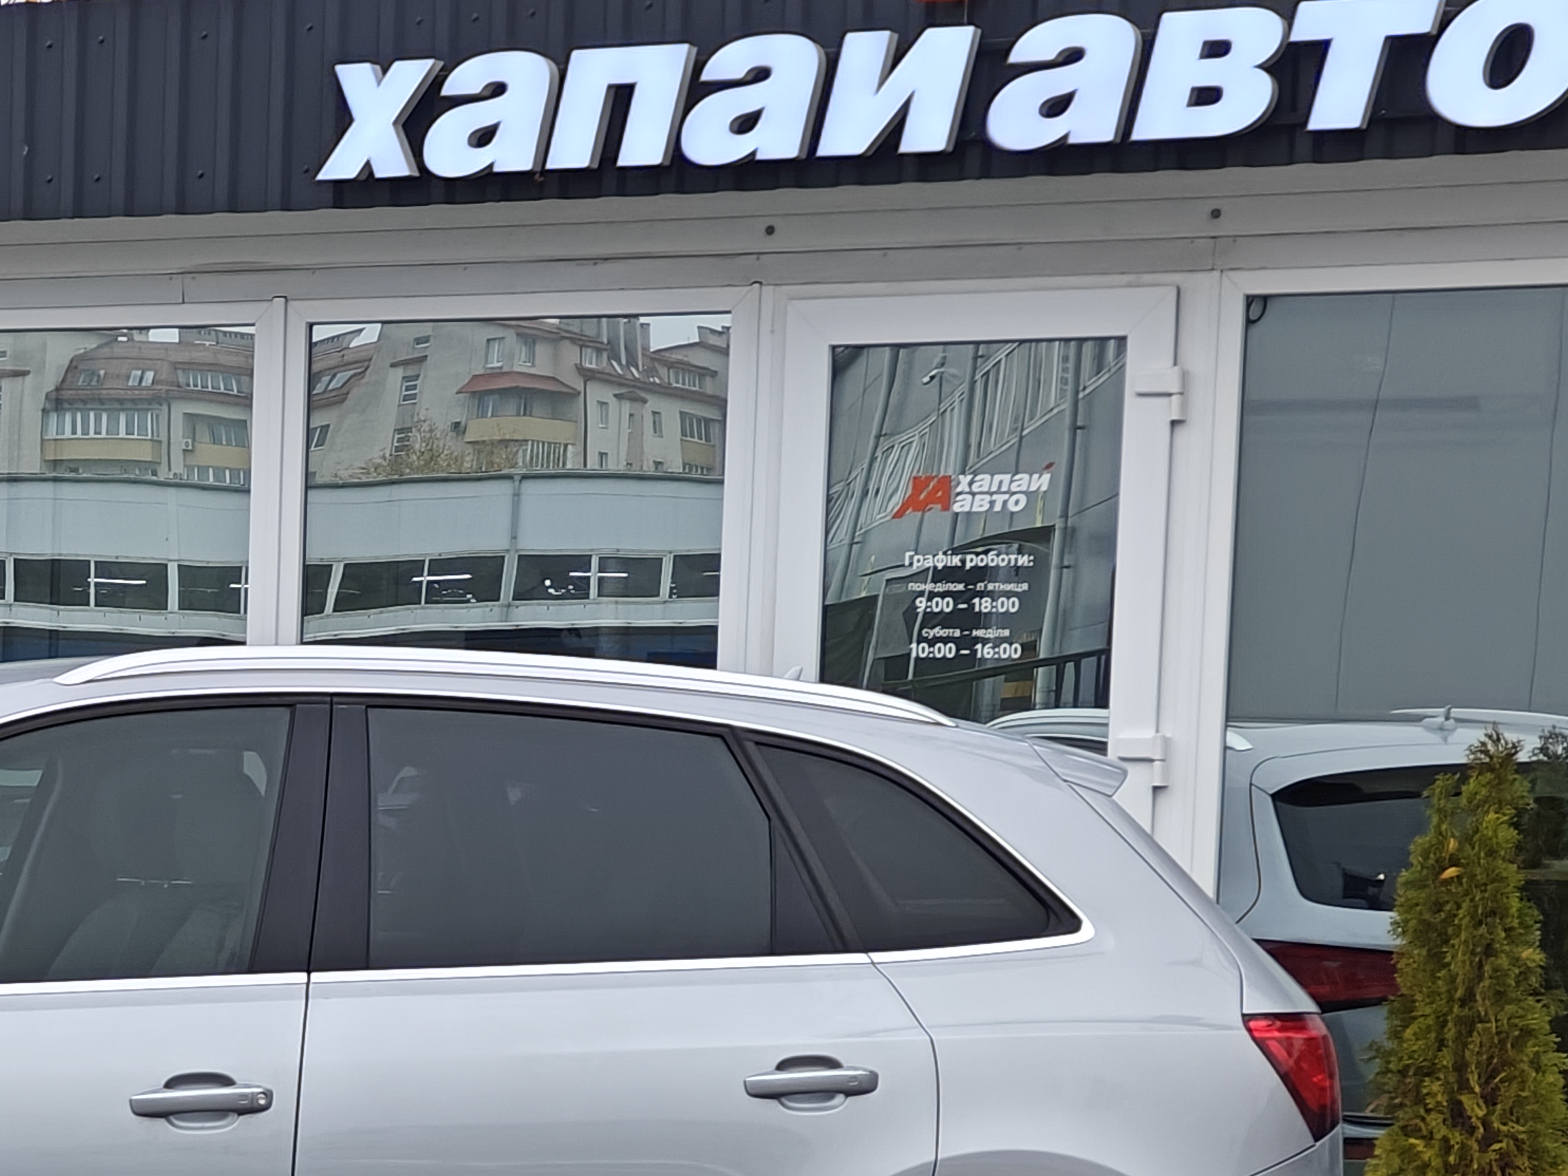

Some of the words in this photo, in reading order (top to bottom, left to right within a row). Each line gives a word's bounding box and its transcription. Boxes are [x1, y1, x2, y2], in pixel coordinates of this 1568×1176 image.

[986, 0, 1568, 152] авто
[954, 462, 1055, 493] хапай
[952, 493, 1028, 513] авто
[904, 551, 962, 570] Графік
[965, 551, 1035, 570] роботи:
[908, 581, 966, 593] понеділок
[915, 597, 954, 613] 9:00
[971, 597, 1020, 613] 18:00
[922, 626, 961, 639] субота
[972, 627, 1010, 639] неділя
[909, 643, 956, 659] 10:00
[974, 643, 1022, 659] 16:00
